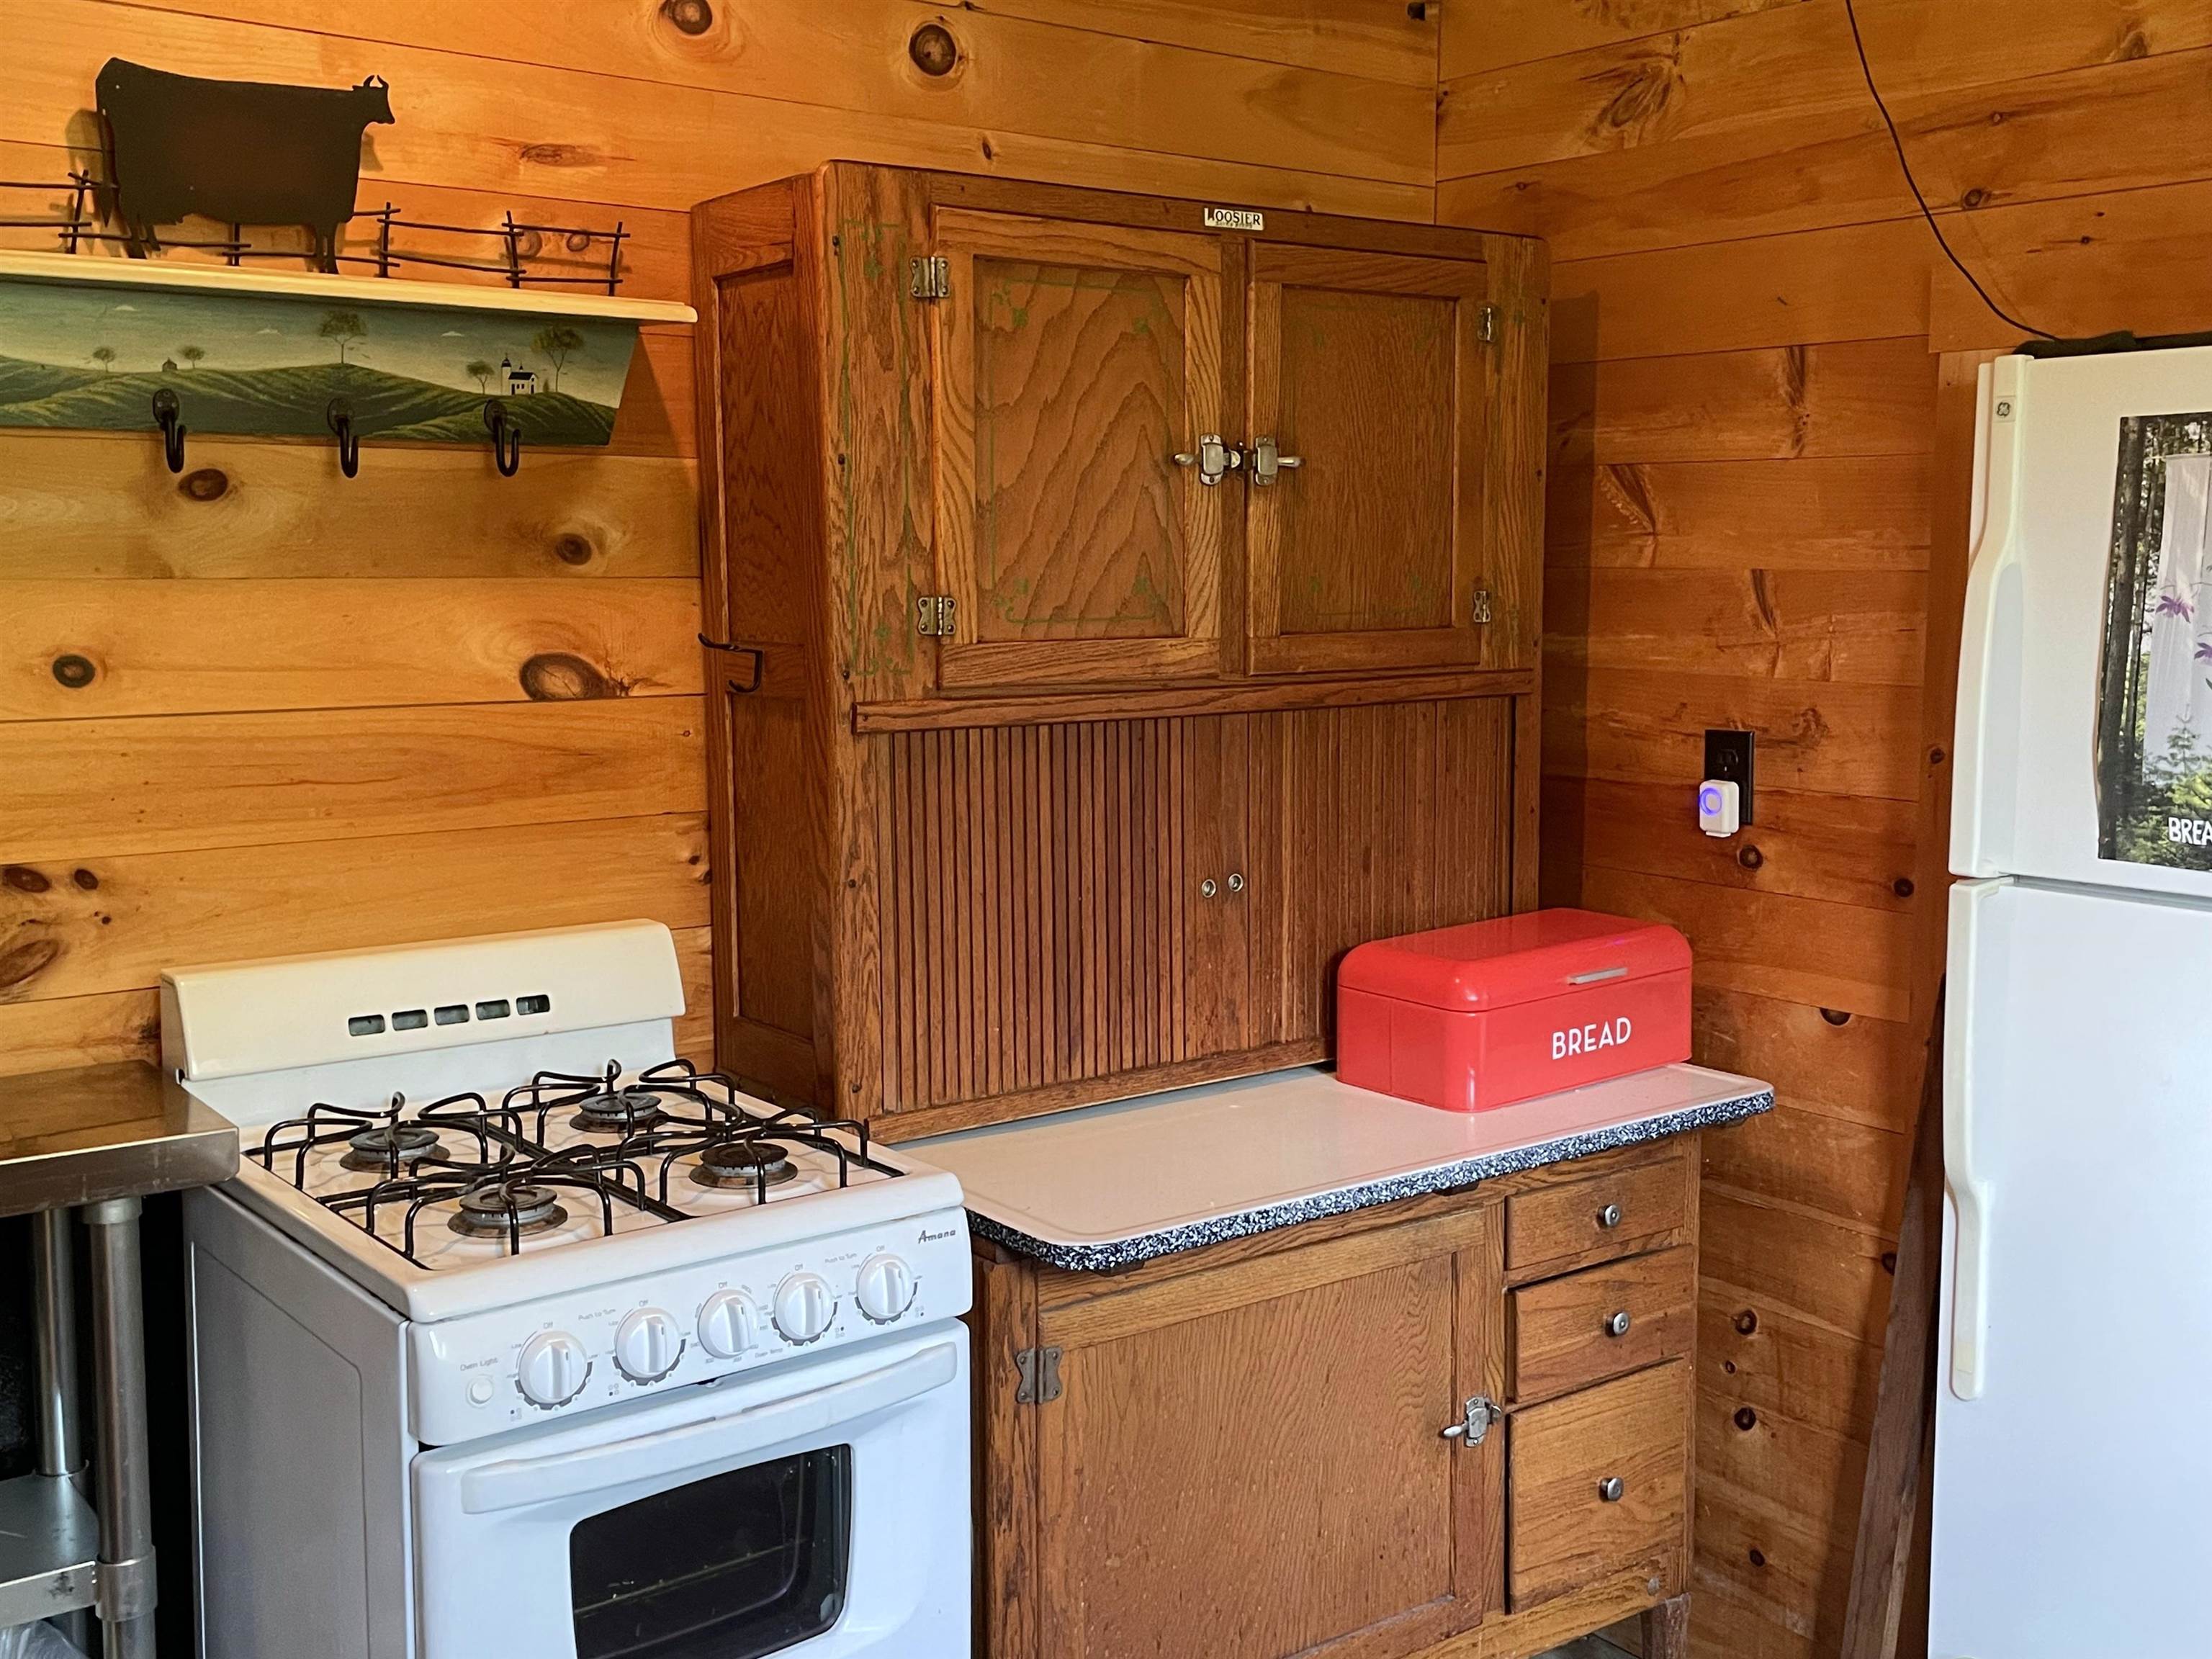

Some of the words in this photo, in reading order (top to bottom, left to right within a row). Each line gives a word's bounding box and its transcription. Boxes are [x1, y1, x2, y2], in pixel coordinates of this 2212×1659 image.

[2168, 817, 2212, 845] BREA
[1552, 1017, 1632, 1060] BREAD
[918, 1229, 956, 1244] Amana
[459, 1362, 479, 1372] Oven
[480, 1357, 498, 1367] Light
